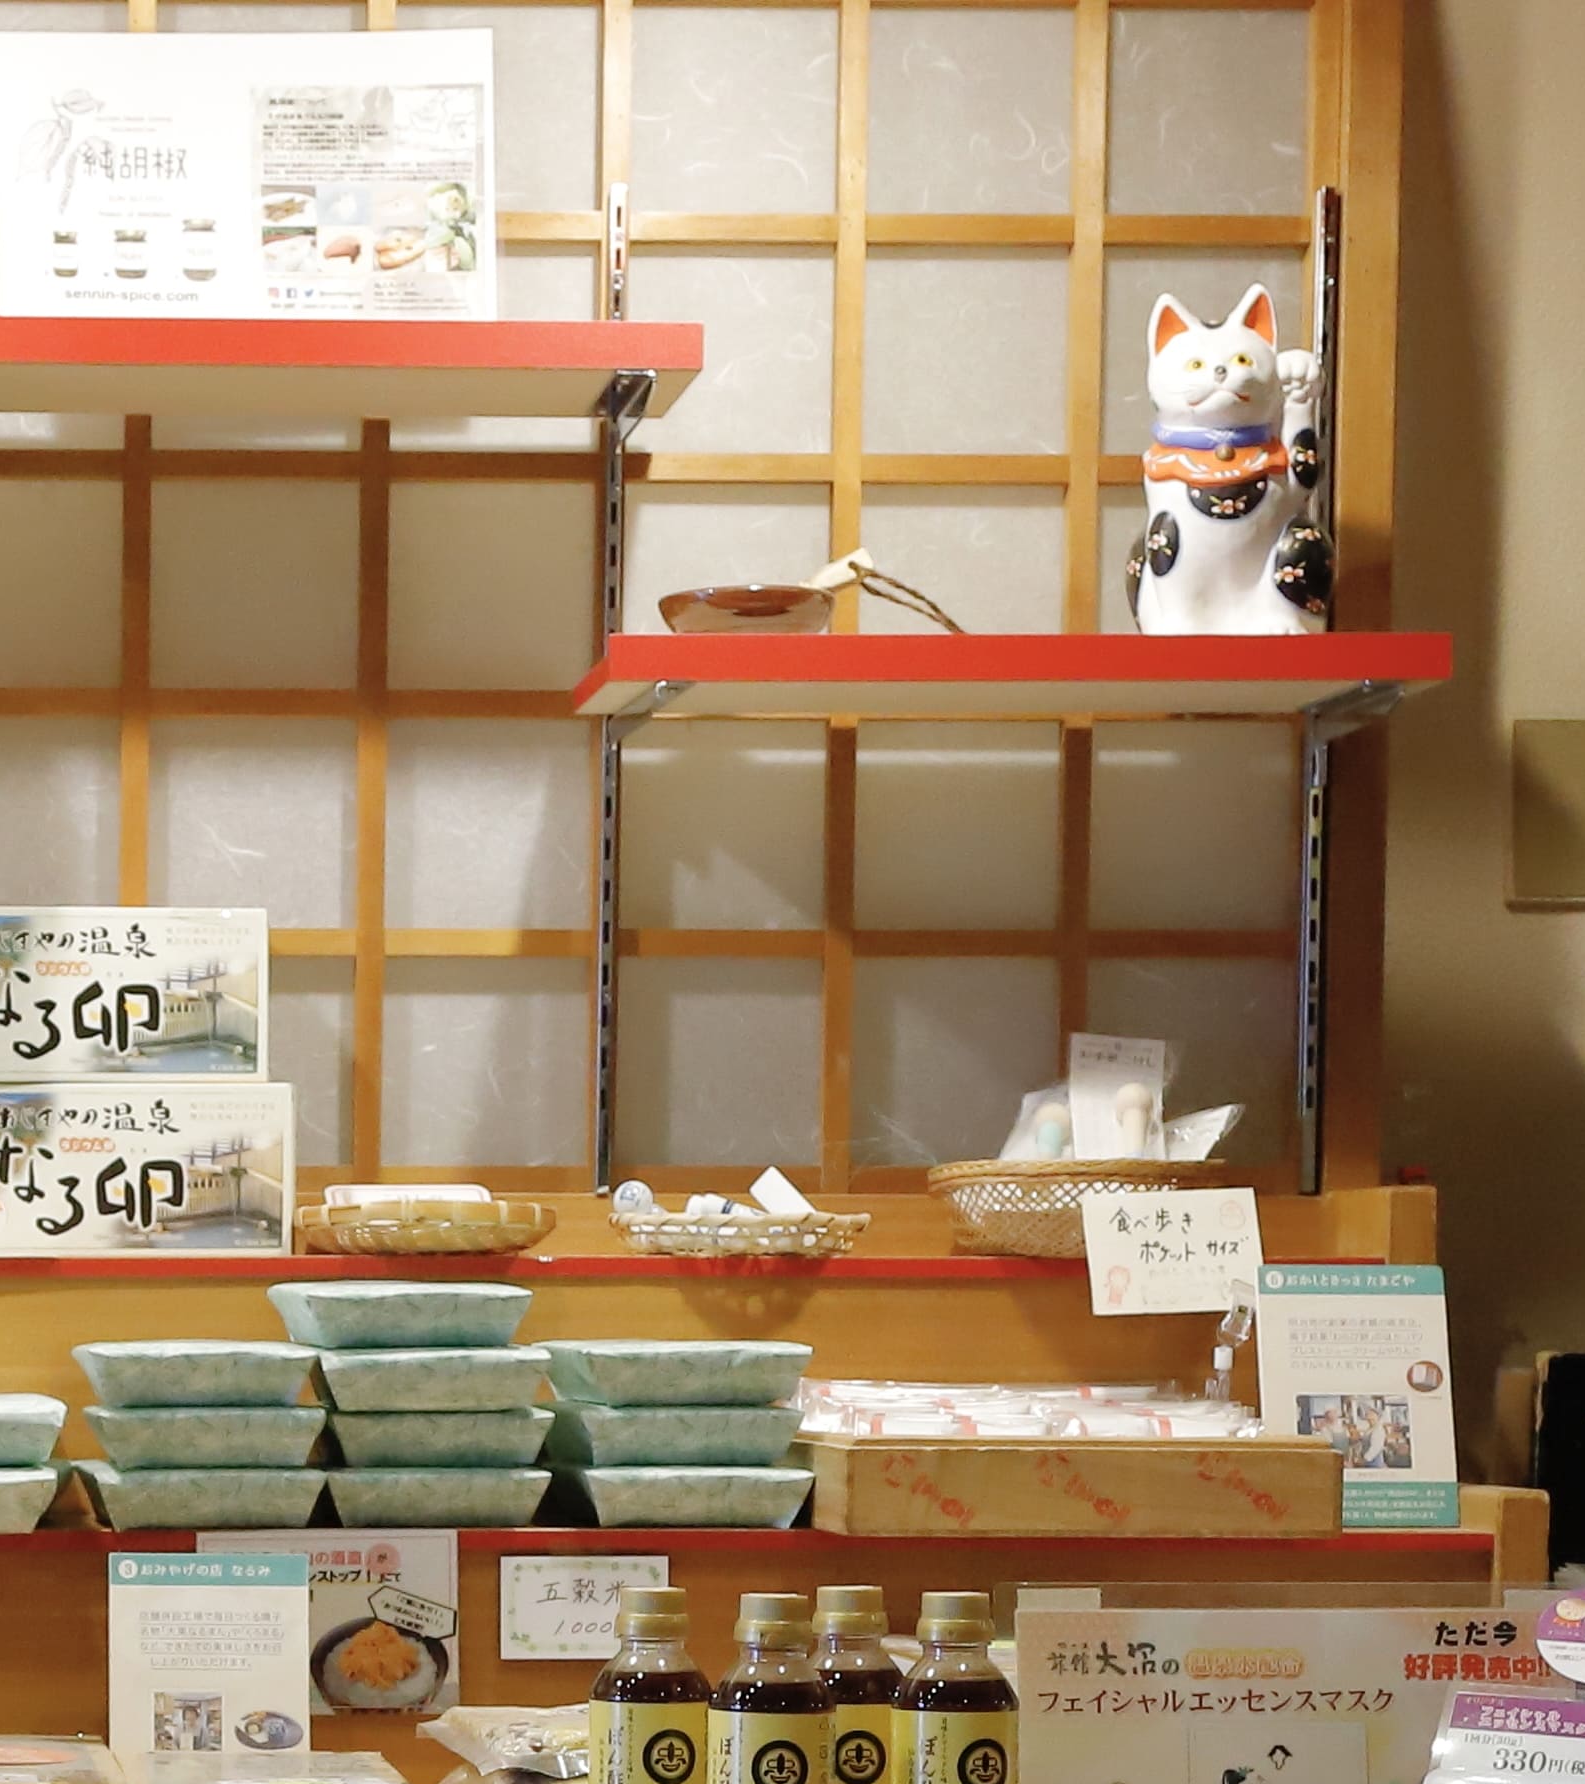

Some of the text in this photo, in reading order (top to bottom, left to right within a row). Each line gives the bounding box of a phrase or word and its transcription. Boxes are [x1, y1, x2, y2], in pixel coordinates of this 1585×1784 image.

[65, 289, 199, 303] sennin-spice.com
[1109, 1207, 1194, 1234] 食べ歩き
[1140, 1236, 1250, 1263] ポケット サイズ
[141, 1563, 222, 1577] おみやげの店
[232, 1564, 270, 1577] なるみ
[538, 1580, 623, 1604] 五穀米
[1435, 1621, 1518, 1647] ただ今
[1403, 1654, 1551, 1681] 好評発売中!!
[1037, 1686, 1395, 1717] フェイシャルエッセンスマスク
